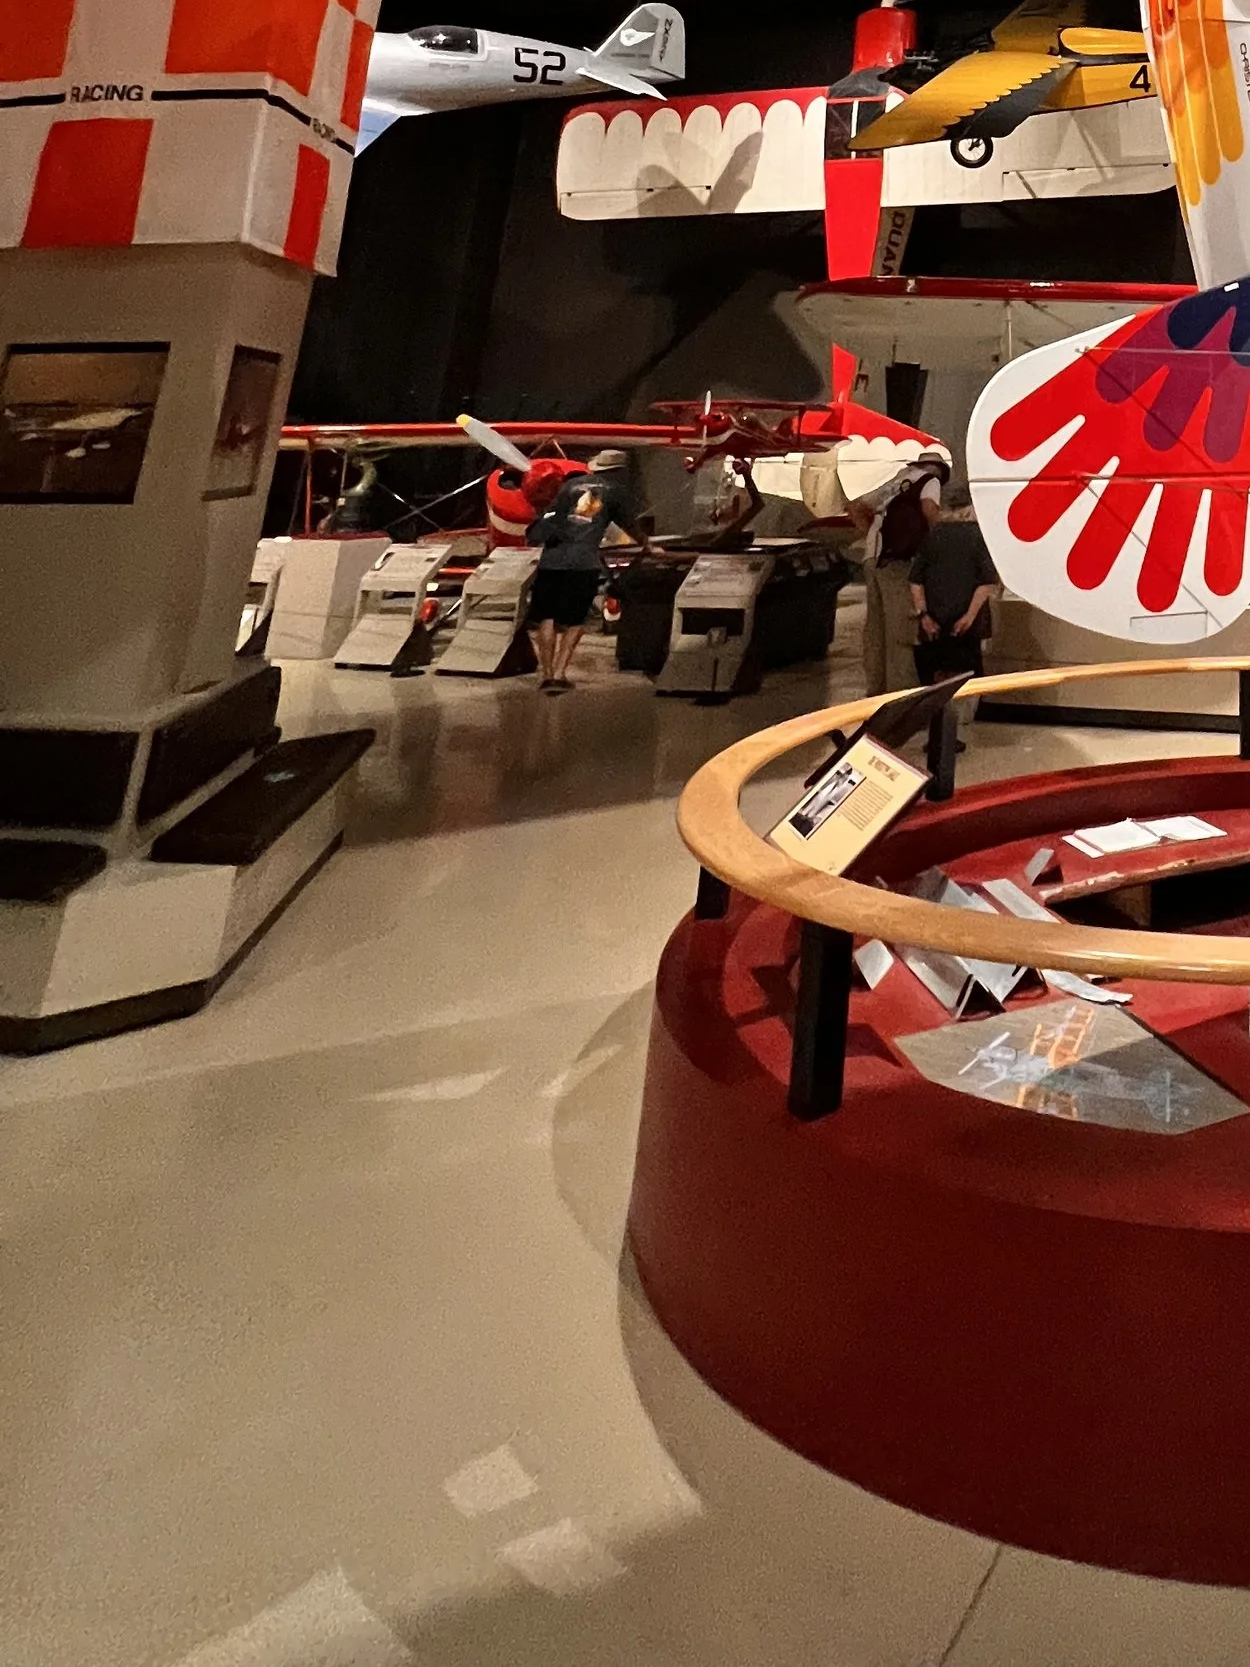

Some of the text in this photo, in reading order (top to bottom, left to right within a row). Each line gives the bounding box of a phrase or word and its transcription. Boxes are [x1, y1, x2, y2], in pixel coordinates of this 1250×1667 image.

[512, 46, 566, 86] 52
[1129, 64, 1151, 93] 4
[70, 84, 144, 103] RACING
